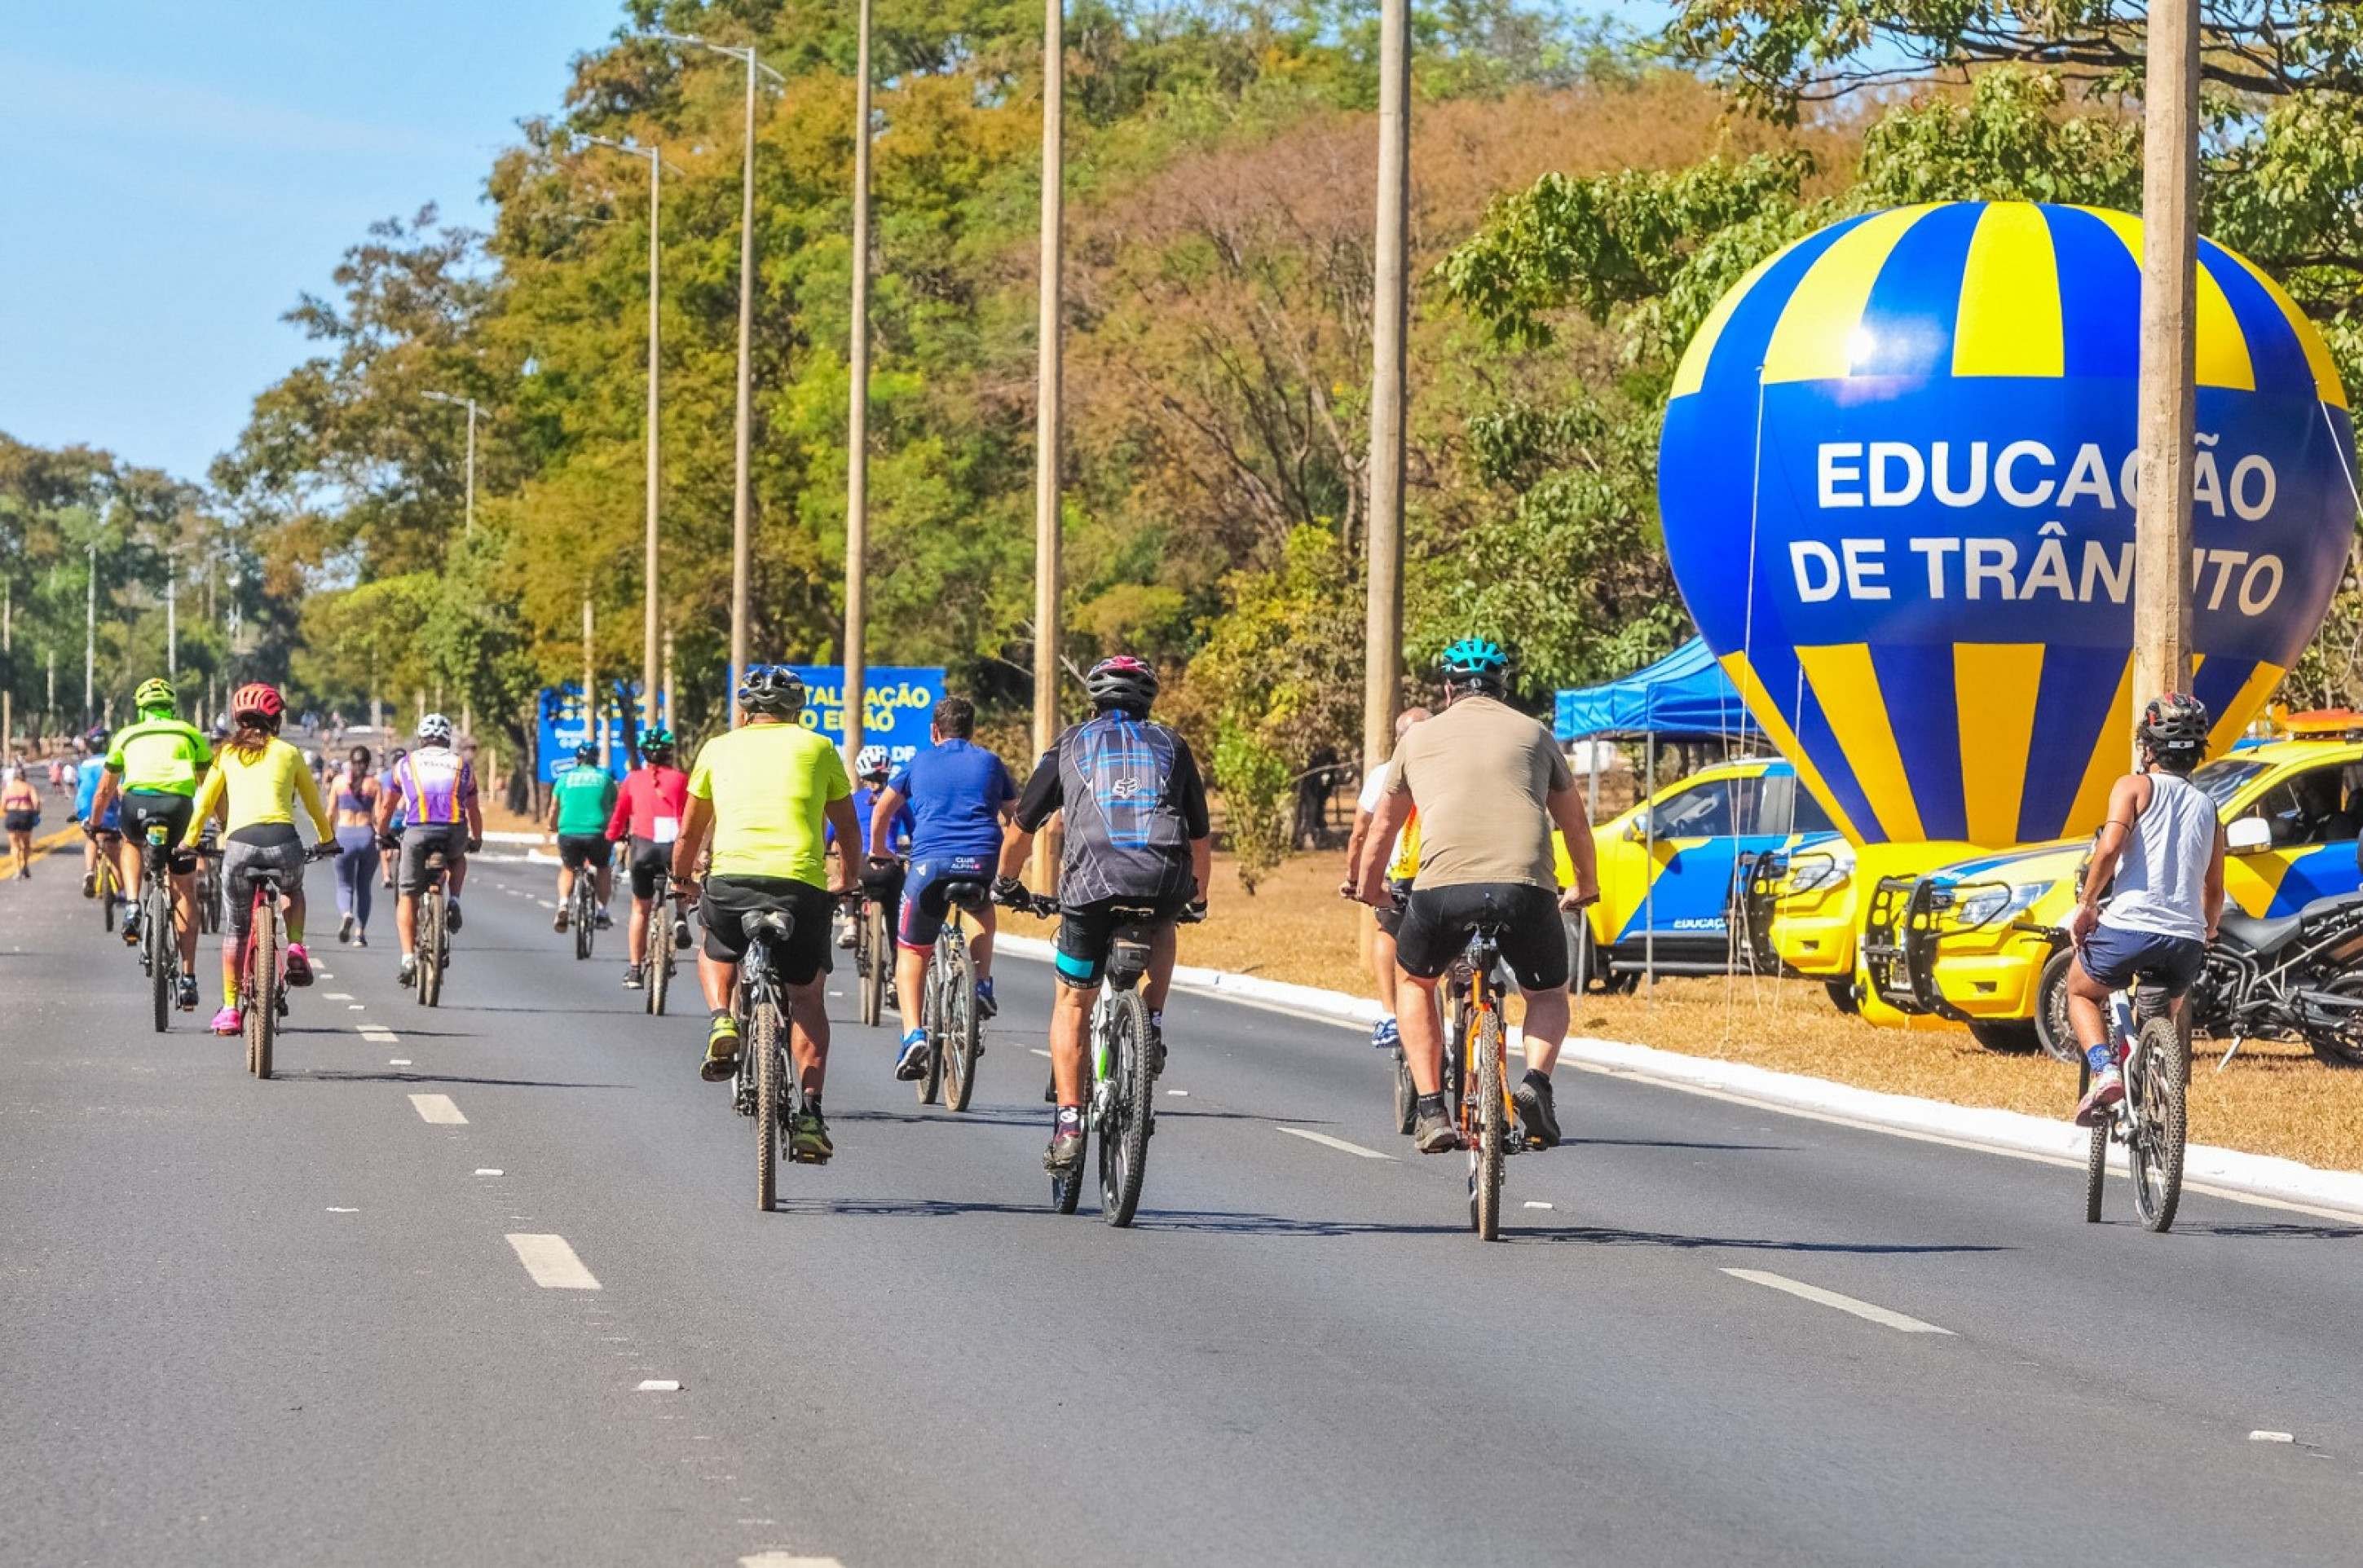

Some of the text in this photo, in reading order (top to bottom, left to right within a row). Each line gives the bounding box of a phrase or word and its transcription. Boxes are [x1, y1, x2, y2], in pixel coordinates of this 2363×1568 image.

[1788, 521, 2284, 616] DE TRÂNTO
[1673, 918, 1726, 930] EDUCAÇ
